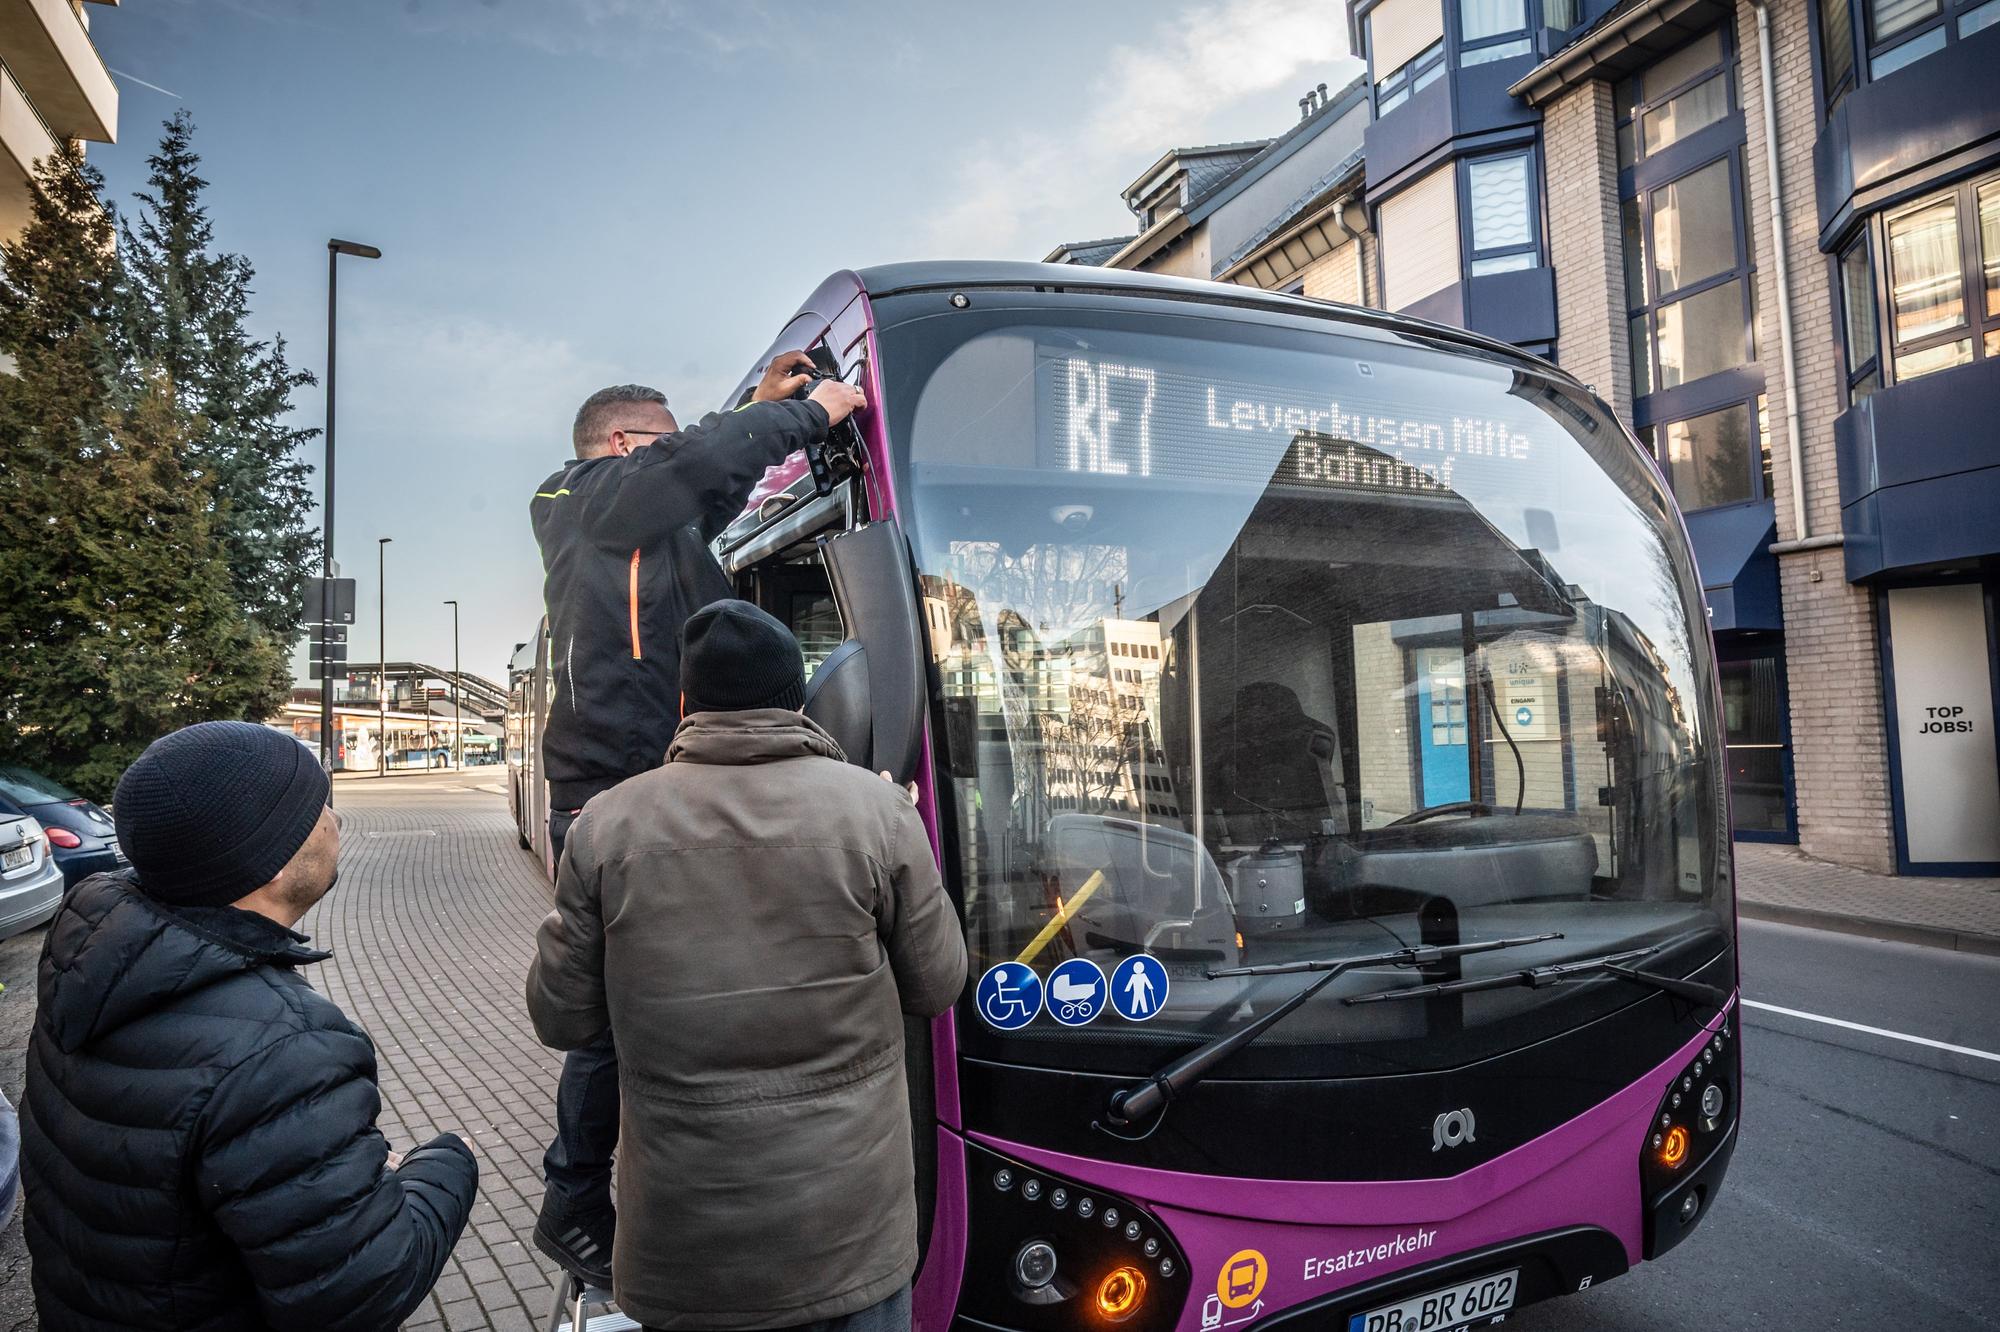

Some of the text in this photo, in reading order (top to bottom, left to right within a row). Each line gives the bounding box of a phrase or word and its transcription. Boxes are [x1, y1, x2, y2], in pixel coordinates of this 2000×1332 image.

[1068, 359, 1155, 476] RE7
[1207, 384, 1529, 459] Leverkusen Mitte
[1298, 440, 1455, 490] Bahnhof
[1919, 720, 1973, 734] JOBS!
[1925, 706, 1963, 718] TOP
[1303, 1228, 1437, 1280] Ersatzverkehr
[1419, 1292, 1456, 1331] BR
[1461, 1276, 1513, 1316] 602
